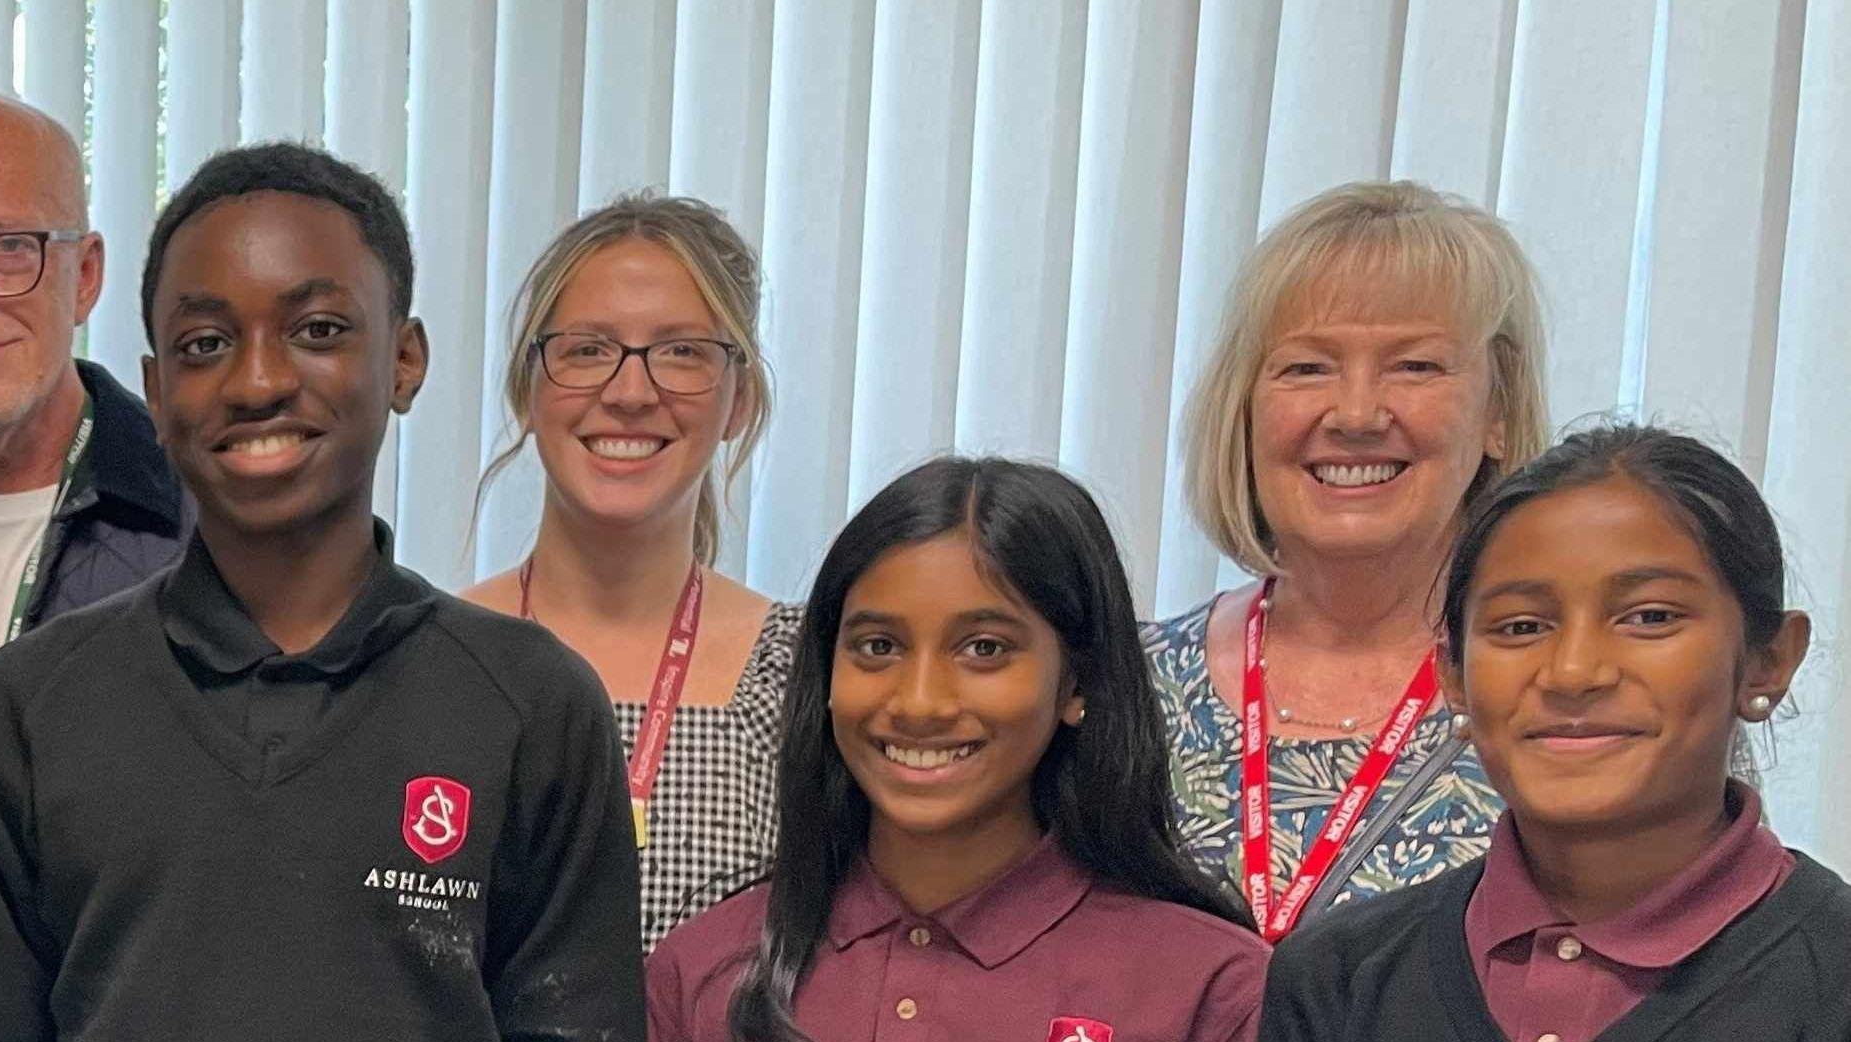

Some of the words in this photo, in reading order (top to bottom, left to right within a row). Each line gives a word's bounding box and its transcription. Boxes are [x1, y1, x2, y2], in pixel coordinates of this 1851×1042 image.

[1246, 700, 1261, 756] VISITOR
[1377, 697, 1423, 755] VISITOR
[1247, 784, 1263, 841] VISITOR
[1323, 785, 1369, 843] VISITOR
[364, 867, 481, 900] ASHLAWN
[397, 893, 450, 911] SCHOOL
[1270, 875, 1315, 931] VISITOR
